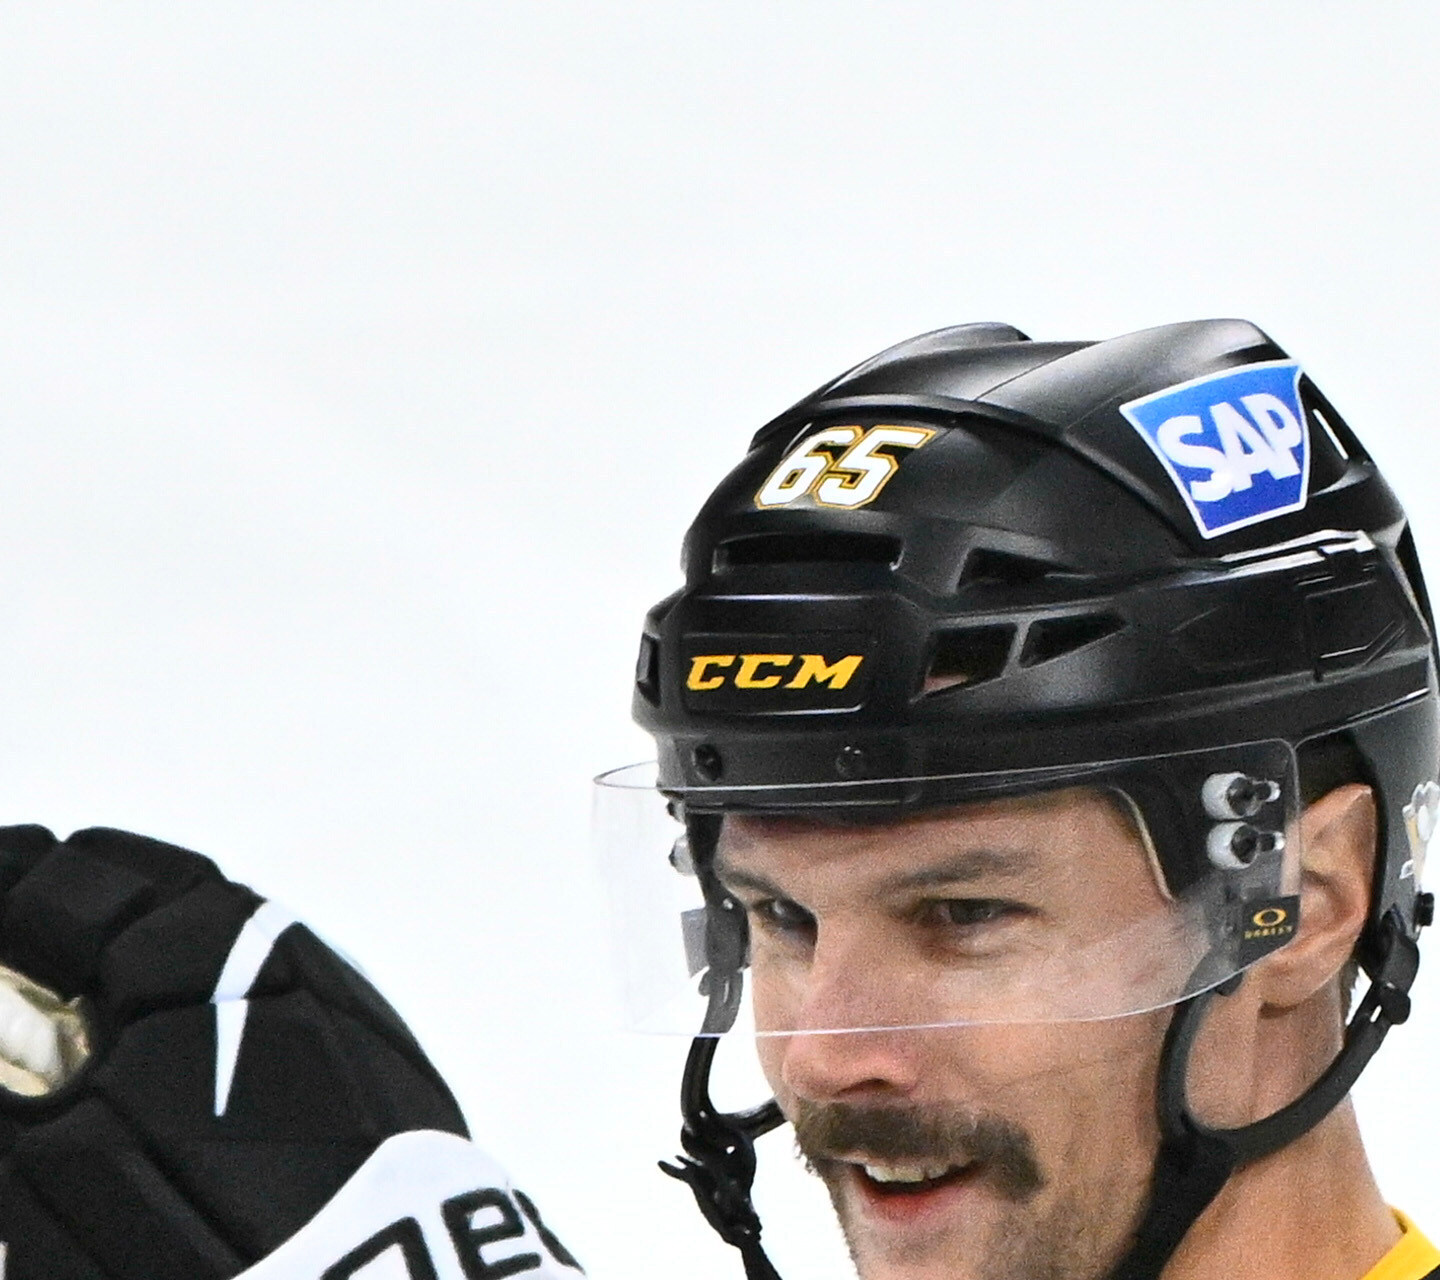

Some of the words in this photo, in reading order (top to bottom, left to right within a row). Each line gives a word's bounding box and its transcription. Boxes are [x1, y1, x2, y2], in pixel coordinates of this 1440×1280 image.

[754, 423, 938, 511] 65
[1157, 391, 1302, 502] SAP
[686, 653, 865, 691] CCM
